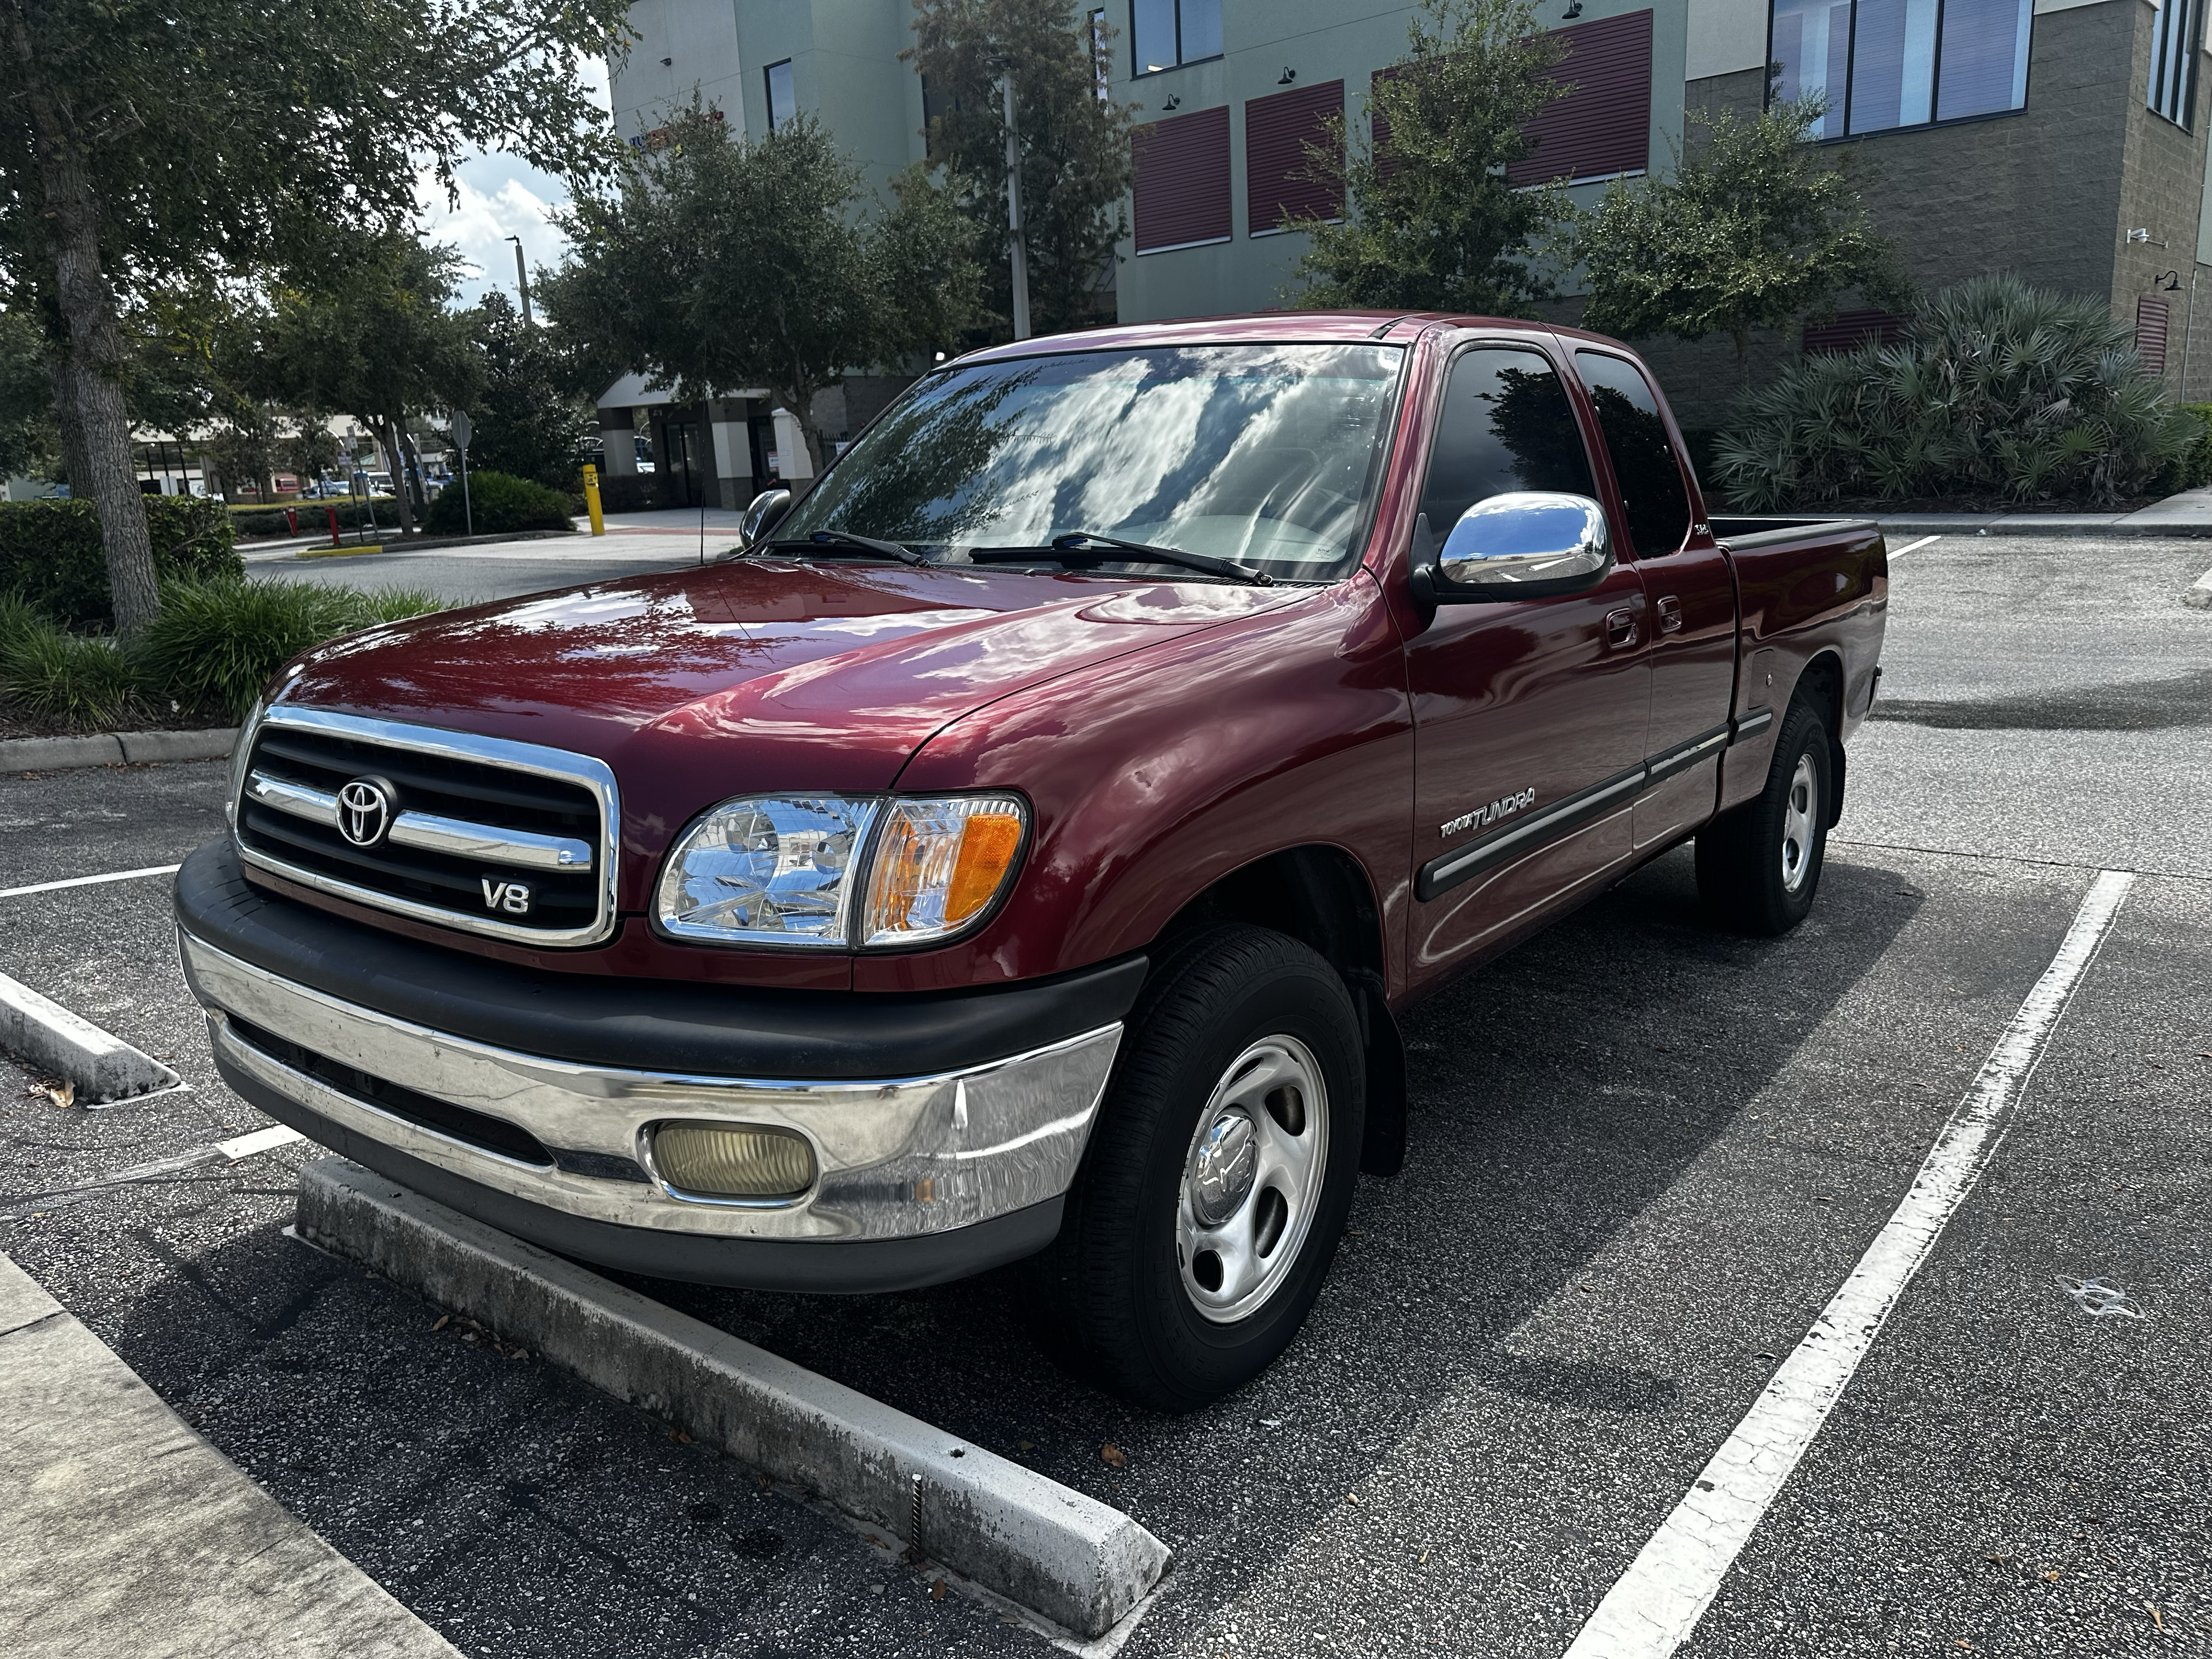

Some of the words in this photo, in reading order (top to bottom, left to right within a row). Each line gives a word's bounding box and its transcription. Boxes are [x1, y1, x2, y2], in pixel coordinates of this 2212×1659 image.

[1440, 814, 1472, 838] TOYOTA
[1471, 786, 1535, 831] TUNDRA
[481, 878, 529, 913] V8
[1308, 991, 1362, 1125] GRABBER
[1154, 1244, 1223, 1381] GENERAL
